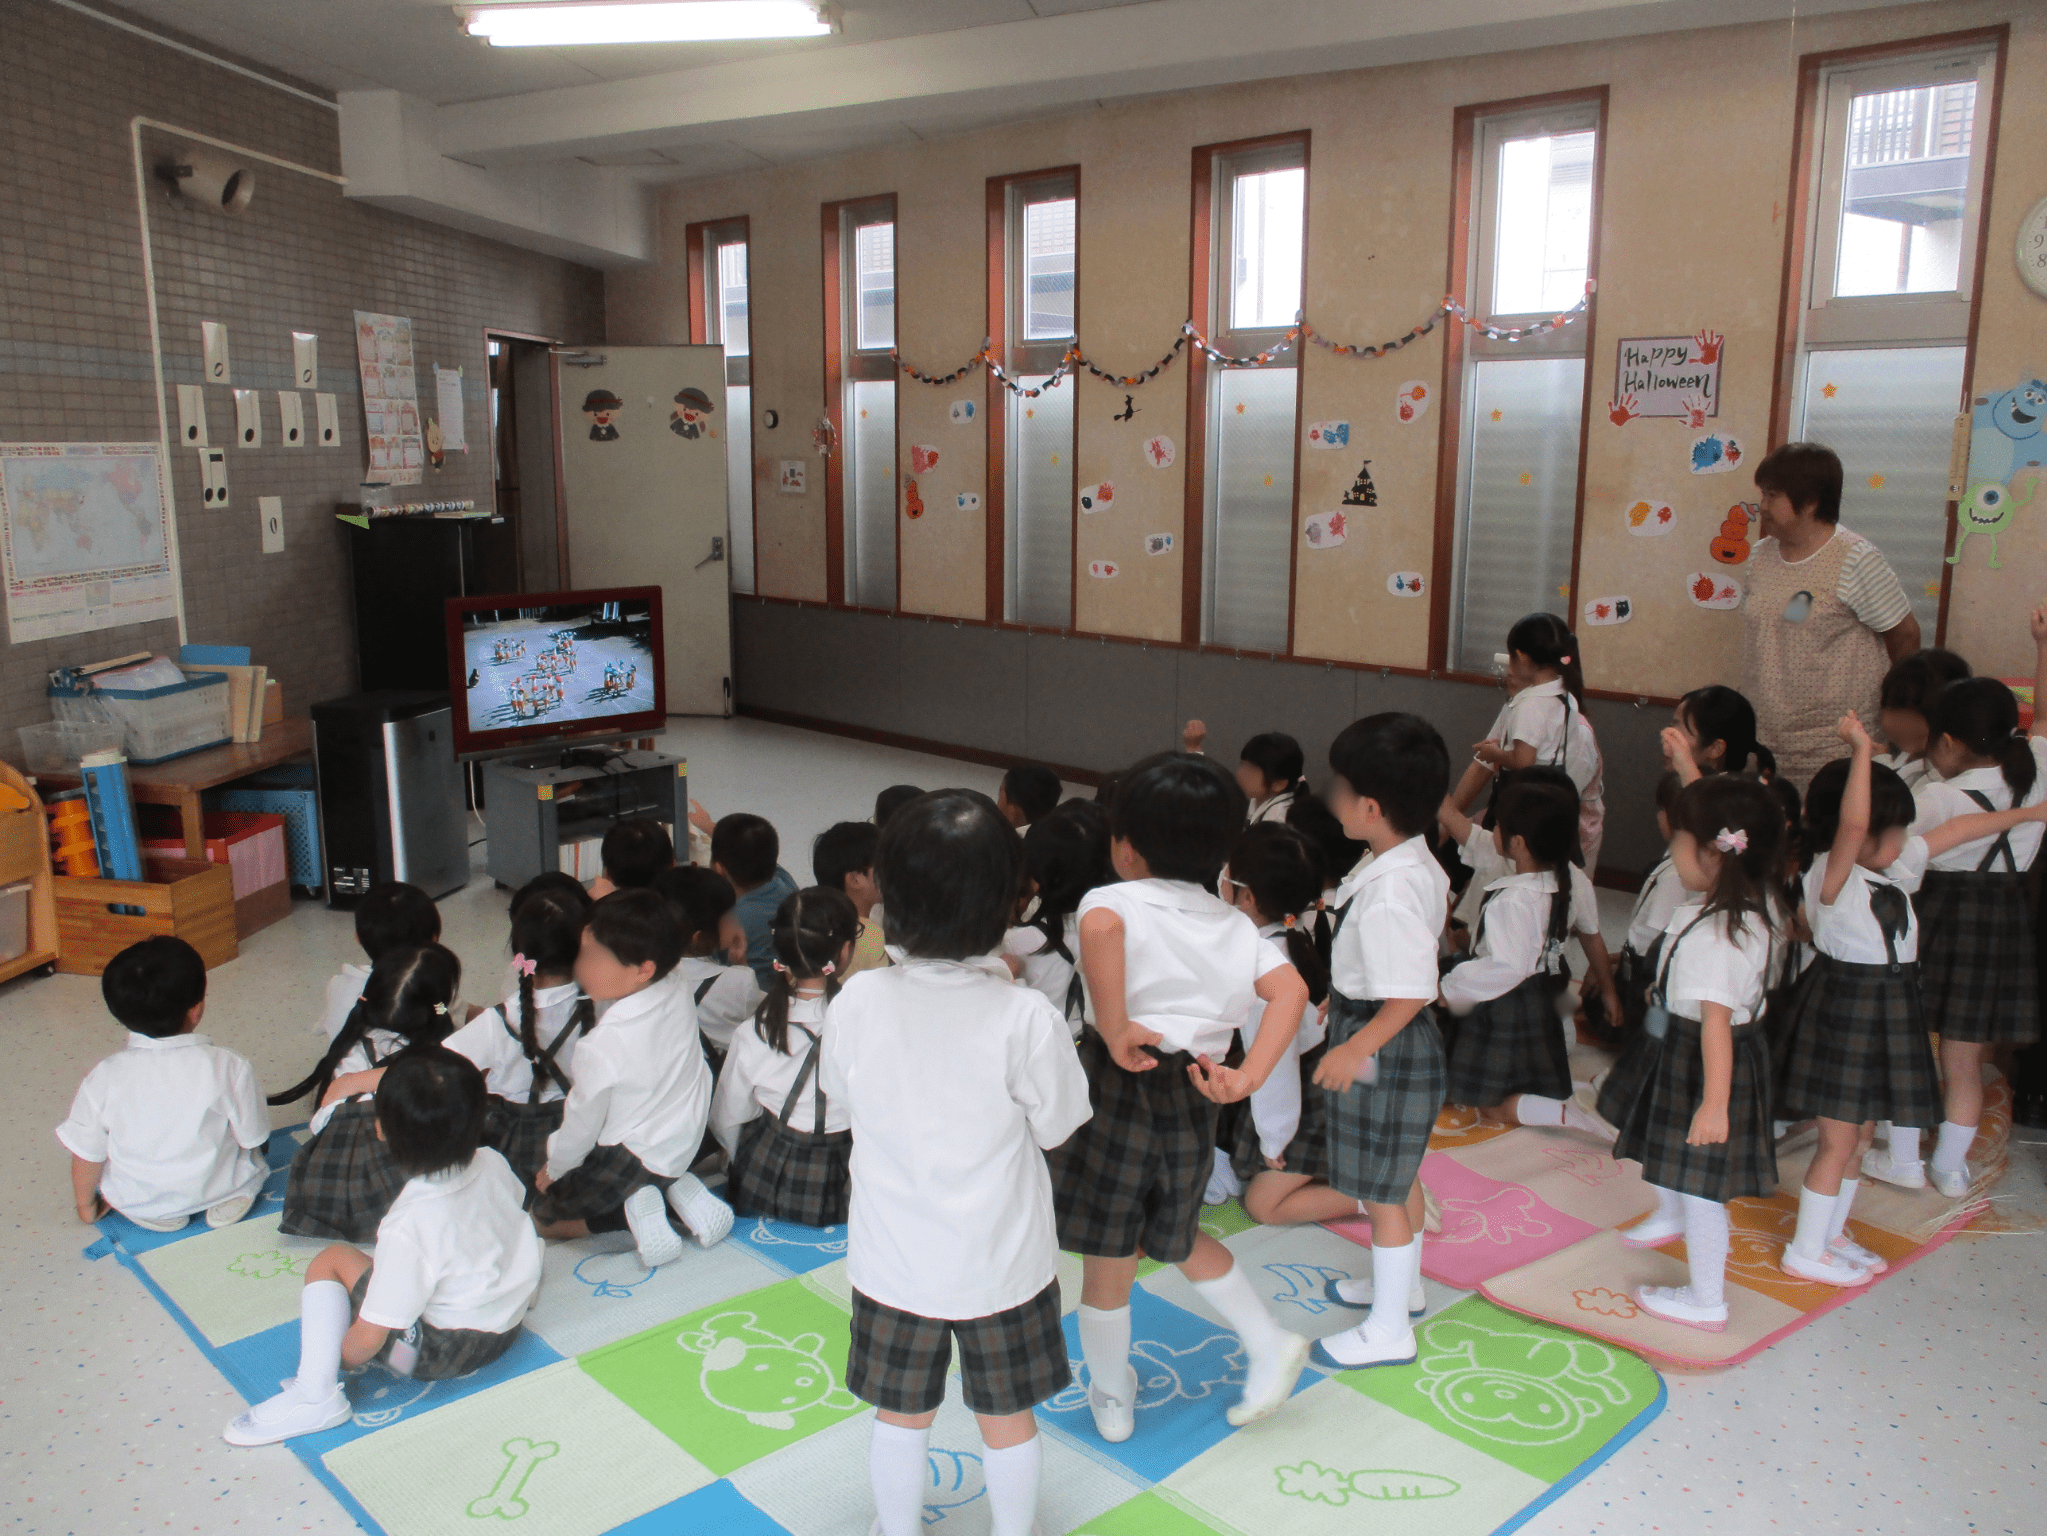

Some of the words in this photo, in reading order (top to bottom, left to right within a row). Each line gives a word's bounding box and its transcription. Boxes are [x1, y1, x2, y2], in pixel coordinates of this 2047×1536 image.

[2034, 233, 2045, 249] 9
[2037, 253, 2047, 268] 8
[1624, 346, 1688, 368] Happy
[1624, 370, 1712, 399] Halloween
